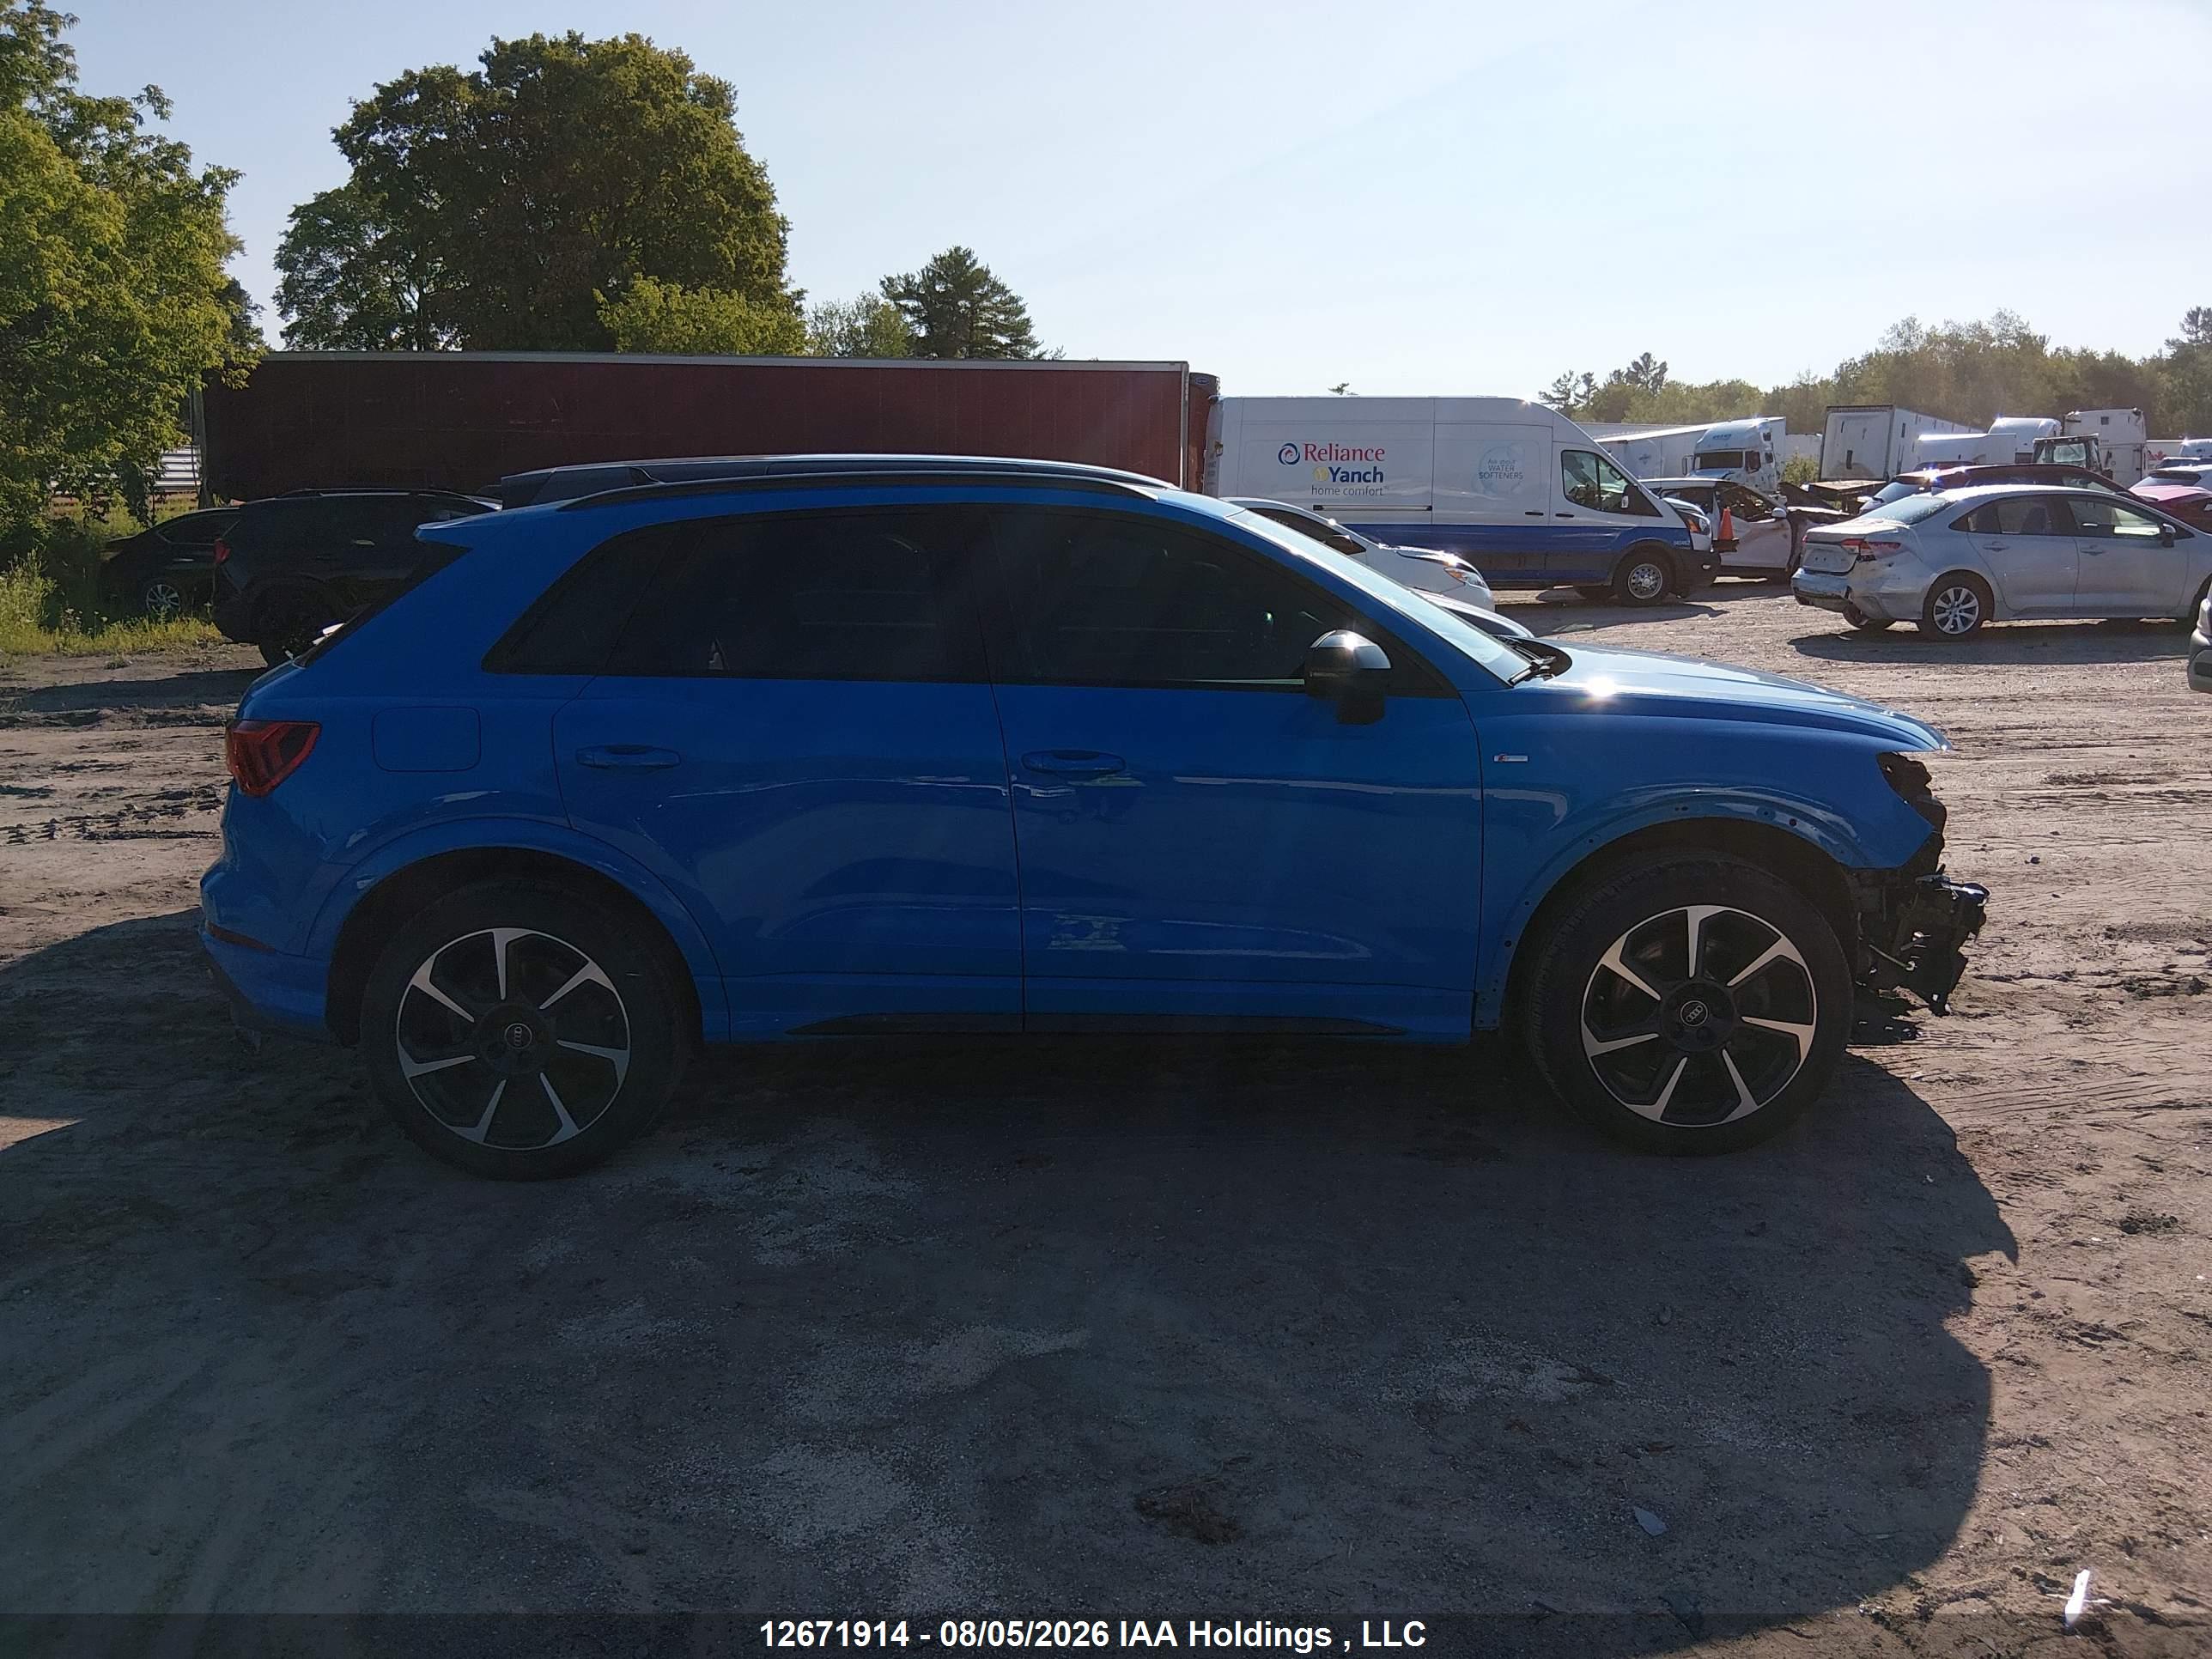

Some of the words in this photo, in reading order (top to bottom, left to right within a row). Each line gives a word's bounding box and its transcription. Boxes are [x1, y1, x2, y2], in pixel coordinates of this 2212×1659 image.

[1304, 443, 1385, 462] Reliance
[1328, 466, 1383, 483] Yanch
[1311, 485, 1340, 495] home
